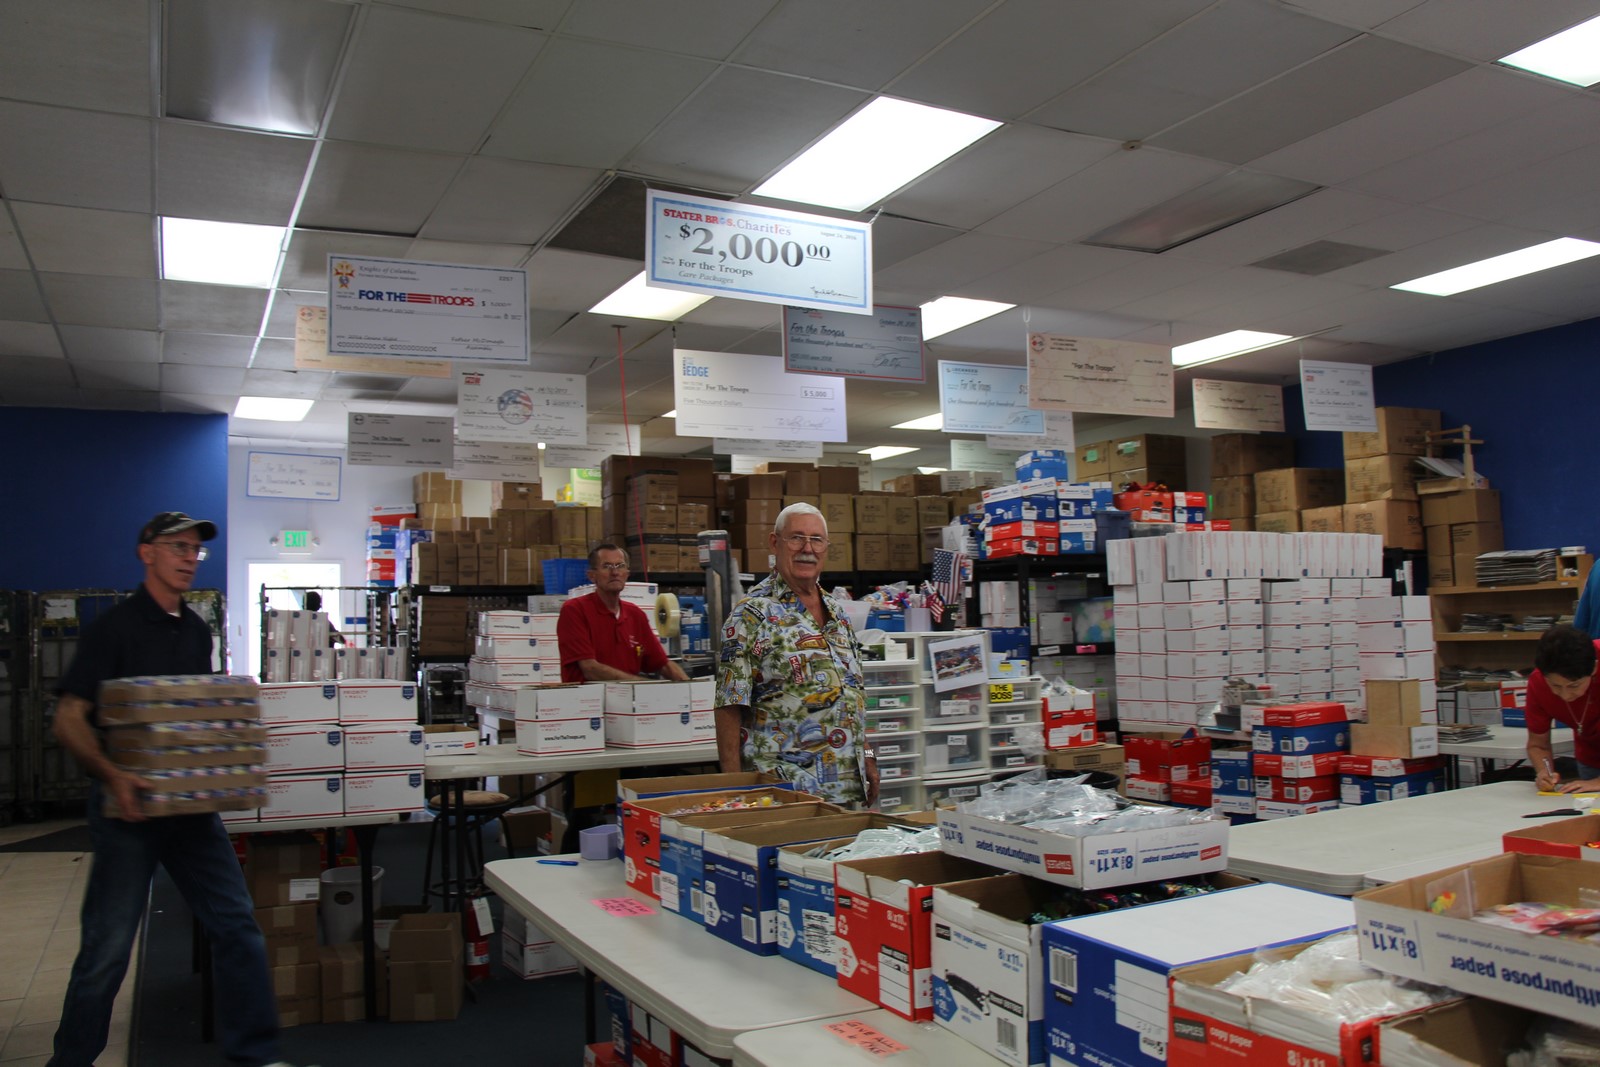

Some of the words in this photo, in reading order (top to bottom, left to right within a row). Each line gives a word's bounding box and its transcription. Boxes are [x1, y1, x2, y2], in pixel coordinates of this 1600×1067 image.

[663, 208, 703, 223] STATER
[737, 219, 791, 236] Charities
[360, 265, 381, 273] Knights
[679, 259, 697, 268] For
[699, 261, 715, 271] the
[719, 264, 753, 276] Troops
[679, 270, 697, 279] Care
[699, 272, 734, 284] Packages
[359, 290, 384, 300] FOR
[386, 292, 406, 302] THE
[431, 295, 475, 306] TROOPS
[790, 322, 803, 332] For
[806, 324, 817, 335] the
[820, 325, 846, 338] Troops
[686, 366, 709, 377] EDGE
[730, 386, 749, 394] Troops
[960, 379, 968, 389] For
[696, 398, 722, 406] Thousand
[285, 531, 307, 547] EXIT
[991, 692, 1013, 700] BOSS
[949, 736, 965, 745] Army
[348, 779, 374, 787] PRIORITY
[975, 839, 994, 852] paper
[995, 845, 1041, 865] multipurpose
[1142, 855, 1159, 863] paper
[1161, 850, 1199, 862] multipurpose
[1097, 858, 1109, 873] 11
[1369, 920, 1383, 928] size
[1386, 924, 1406, 935] letter
[1372, 932, 1387, 951] 11
[1389, 936, 1399, 951] x
[1451, 956, 1496, 978] paper
[1174, 1021, 1205, 1037] STAPLES
[1210, 1027, 1228, 1042] copy
[1230, 1033, 1253, 1048] paper
